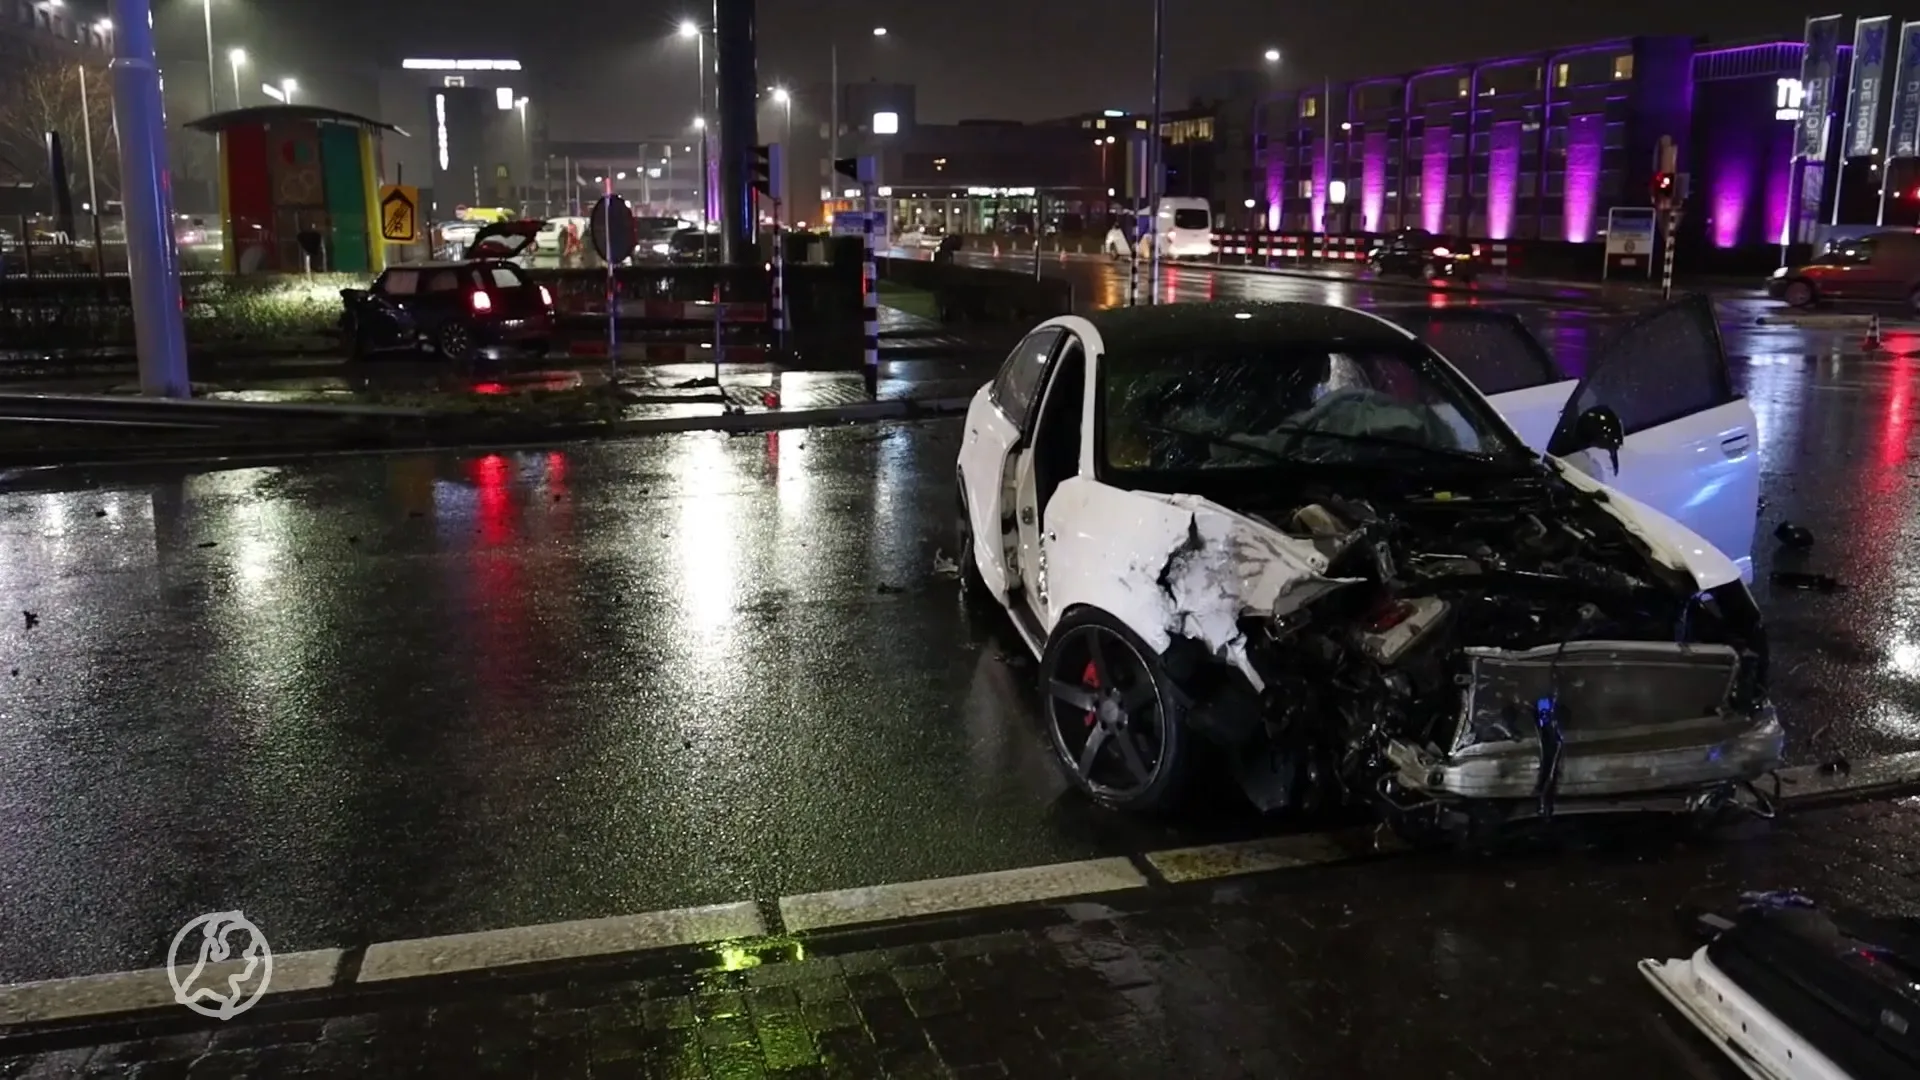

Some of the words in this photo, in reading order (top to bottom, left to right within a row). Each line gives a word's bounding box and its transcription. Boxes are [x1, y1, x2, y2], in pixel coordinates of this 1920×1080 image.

[1861, 78, 1873, 102] DE
[1906, 81, 1920, 103] DE
[1854, 105, 1870, 151] HOEK
[1898, 107, 1916, 152] HOEK
